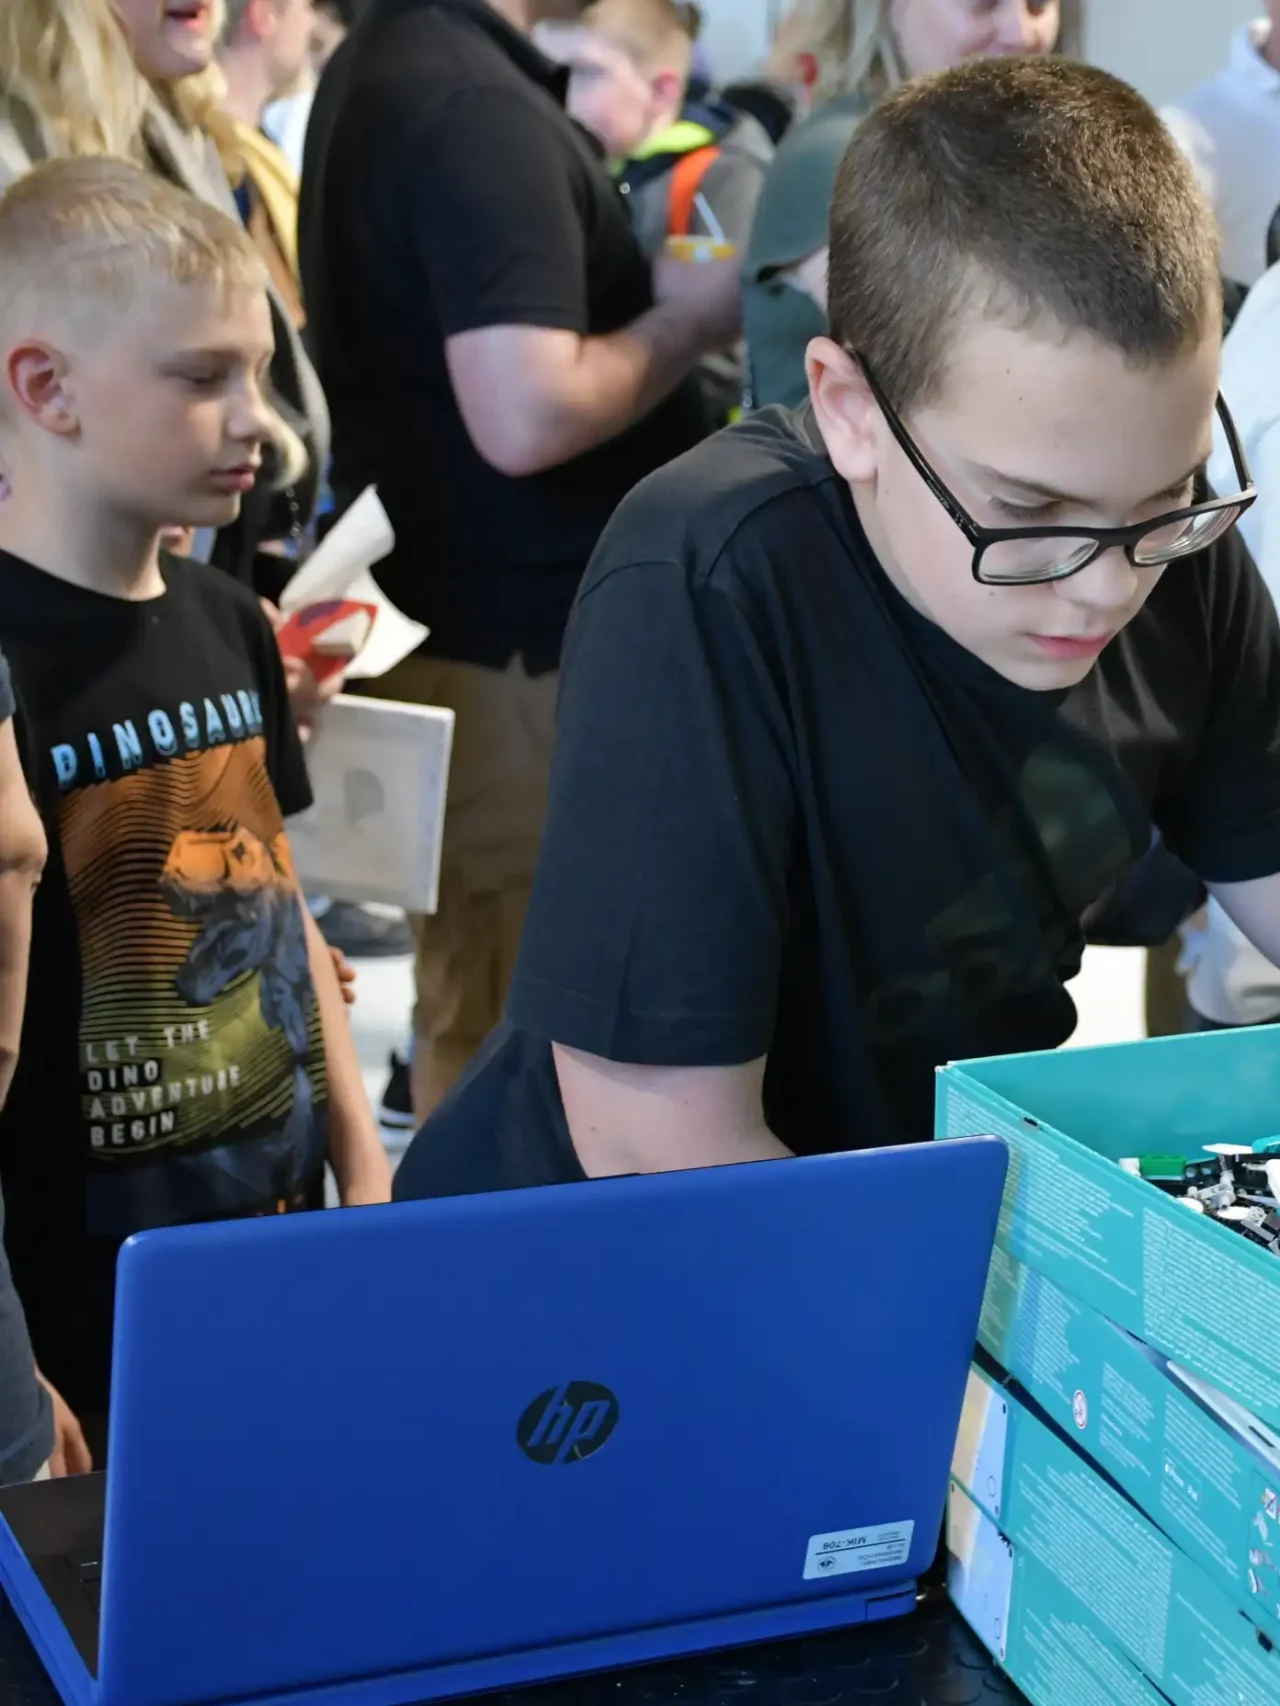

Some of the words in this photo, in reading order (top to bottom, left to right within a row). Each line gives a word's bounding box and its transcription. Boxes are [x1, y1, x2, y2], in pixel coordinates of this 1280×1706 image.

[86, 1036, 138, 1063] LET
[163, 1019, 210, 1049] THE
[88, 1060, 159, 1092] DINO
[90, 1064, 240, 1119] ADVENTURE
[90, 1111, 175, 1147] BEGIN
[524, 1384, 614, 1464] hp
